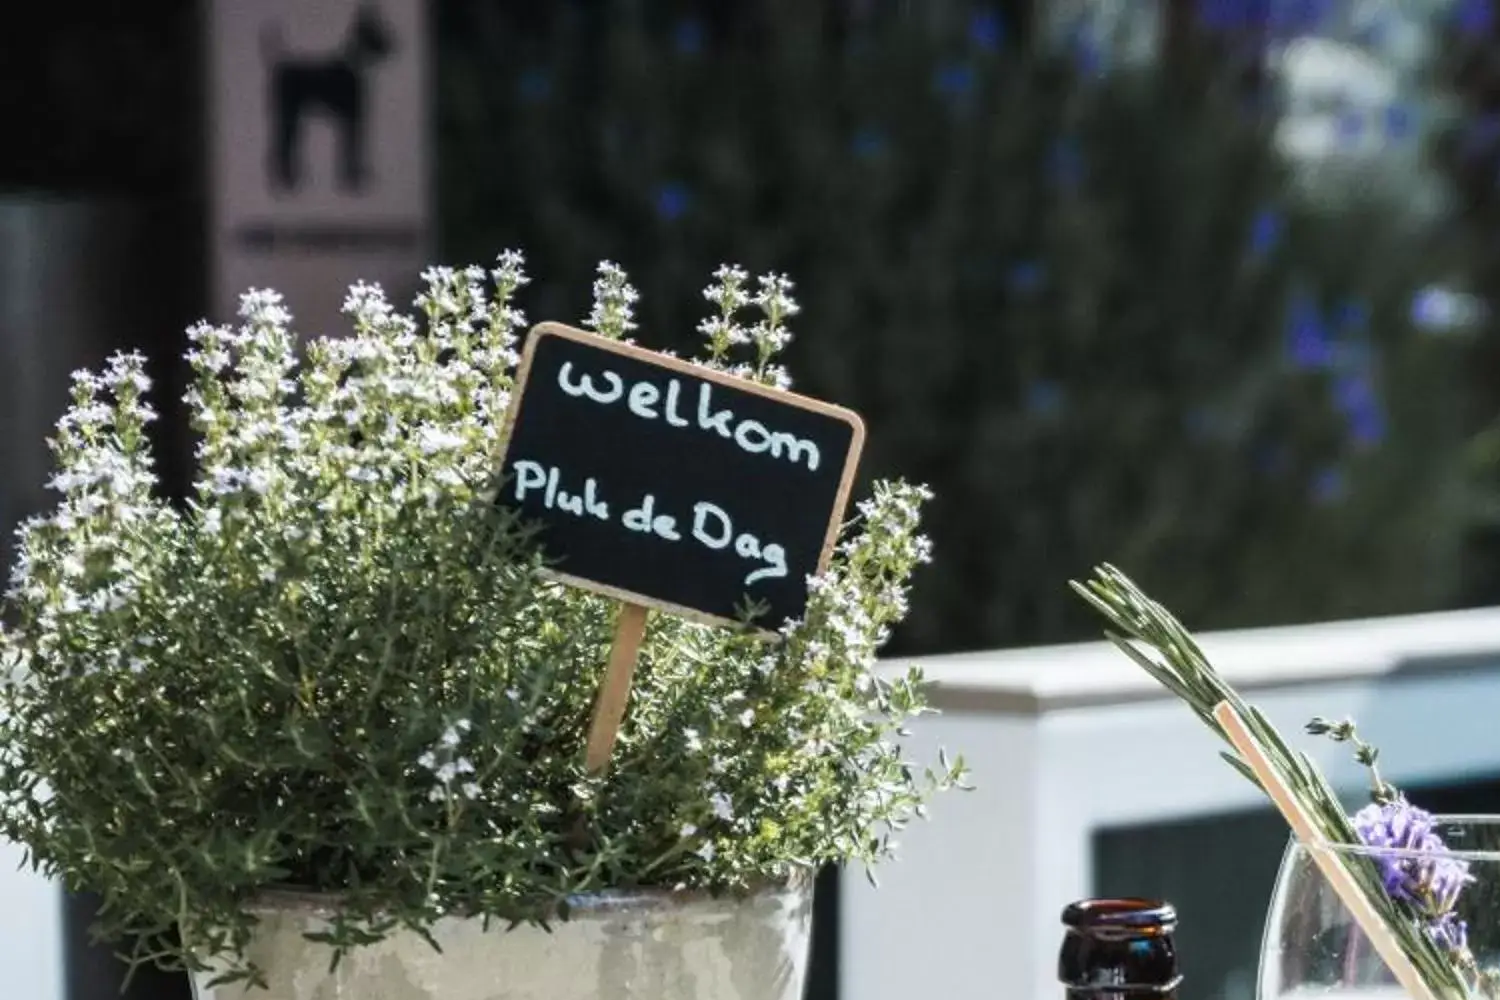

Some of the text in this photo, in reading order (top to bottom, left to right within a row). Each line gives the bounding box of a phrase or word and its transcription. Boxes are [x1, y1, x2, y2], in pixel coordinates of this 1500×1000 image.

[558, 361, 821, 471] welkom
[621, 494, 682, 541] de
[692, 502, 789, 586] Dag
